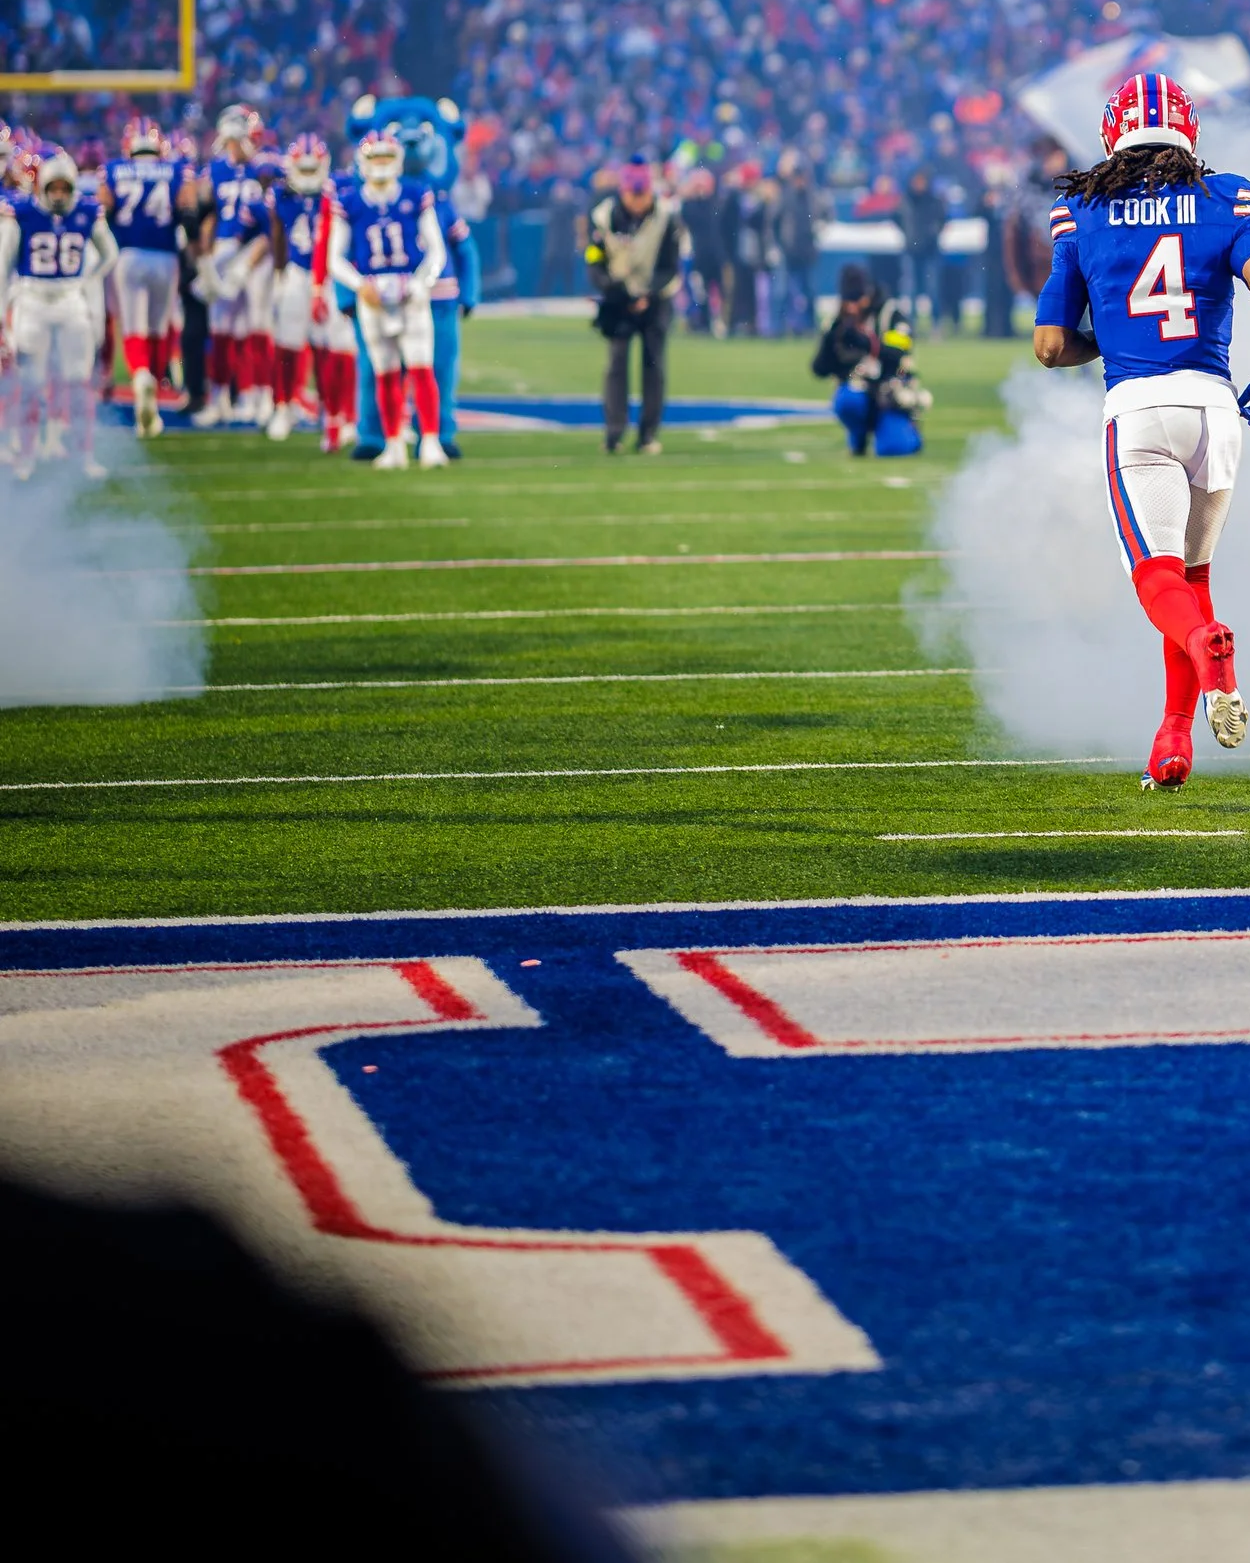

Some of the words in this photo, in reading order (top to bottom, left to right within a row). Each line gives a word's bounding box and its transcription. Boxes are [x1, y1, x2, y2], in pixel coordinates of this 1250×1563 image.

[114, 179, 172, 228] 74
[1108, 196, 1171, 226] COOK
[1176, 194, 1196, 225] III
[30, 231, 84, 276] 26
[366, 221, 410, 269] 11
[1126, 233, 1199, 342] 4
